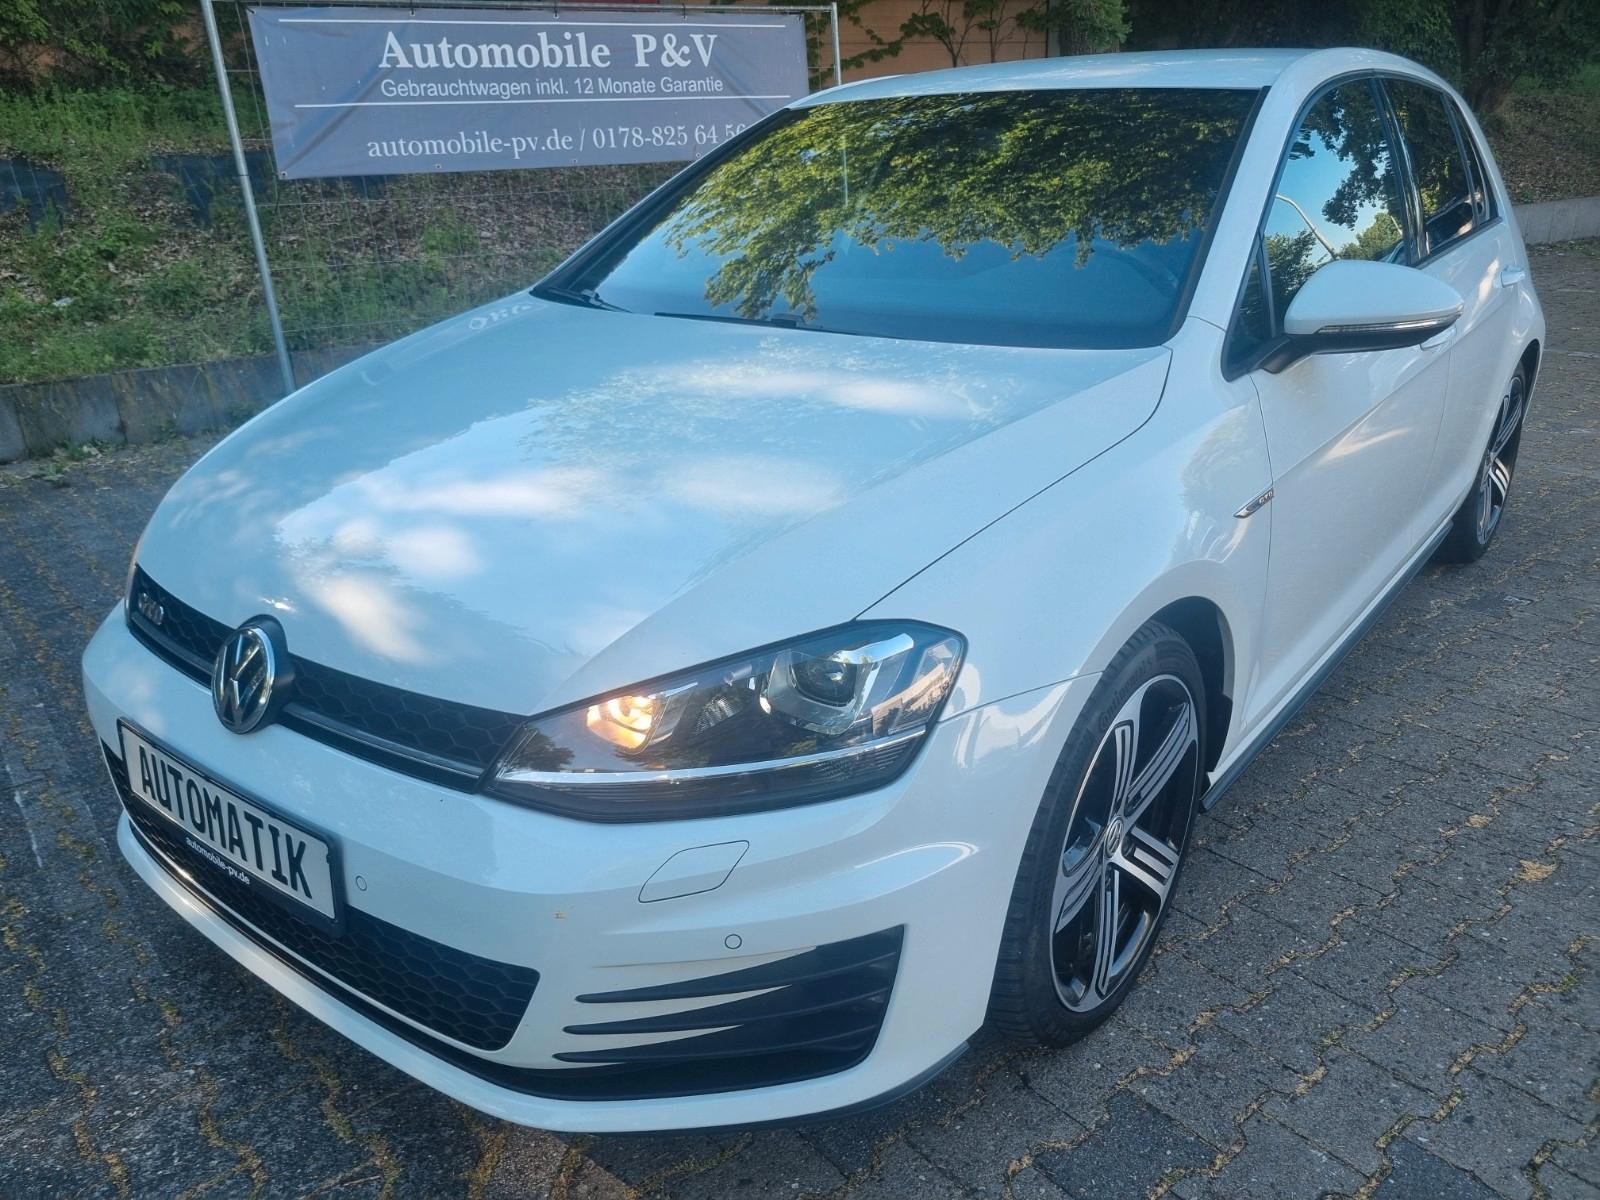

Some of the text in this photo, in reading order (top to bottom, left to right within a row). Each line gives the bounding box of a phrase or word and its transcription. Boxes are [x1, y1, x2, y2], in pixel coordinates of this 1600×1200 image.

[378, 31, 717, 68] Automobile P&V
[380, 76, 724, 99] Gebrauchtwagen inkl. 12 Monate Garantie
[367, 128, 573, 159] automobile-pv.de
[592, 125, 688, 149] 0178-825
[694, 124, 719, 145] 64
[138, 744, 313, 900] AUTOMATIK
[186, 836, 250, 885] automobile-pv.de
